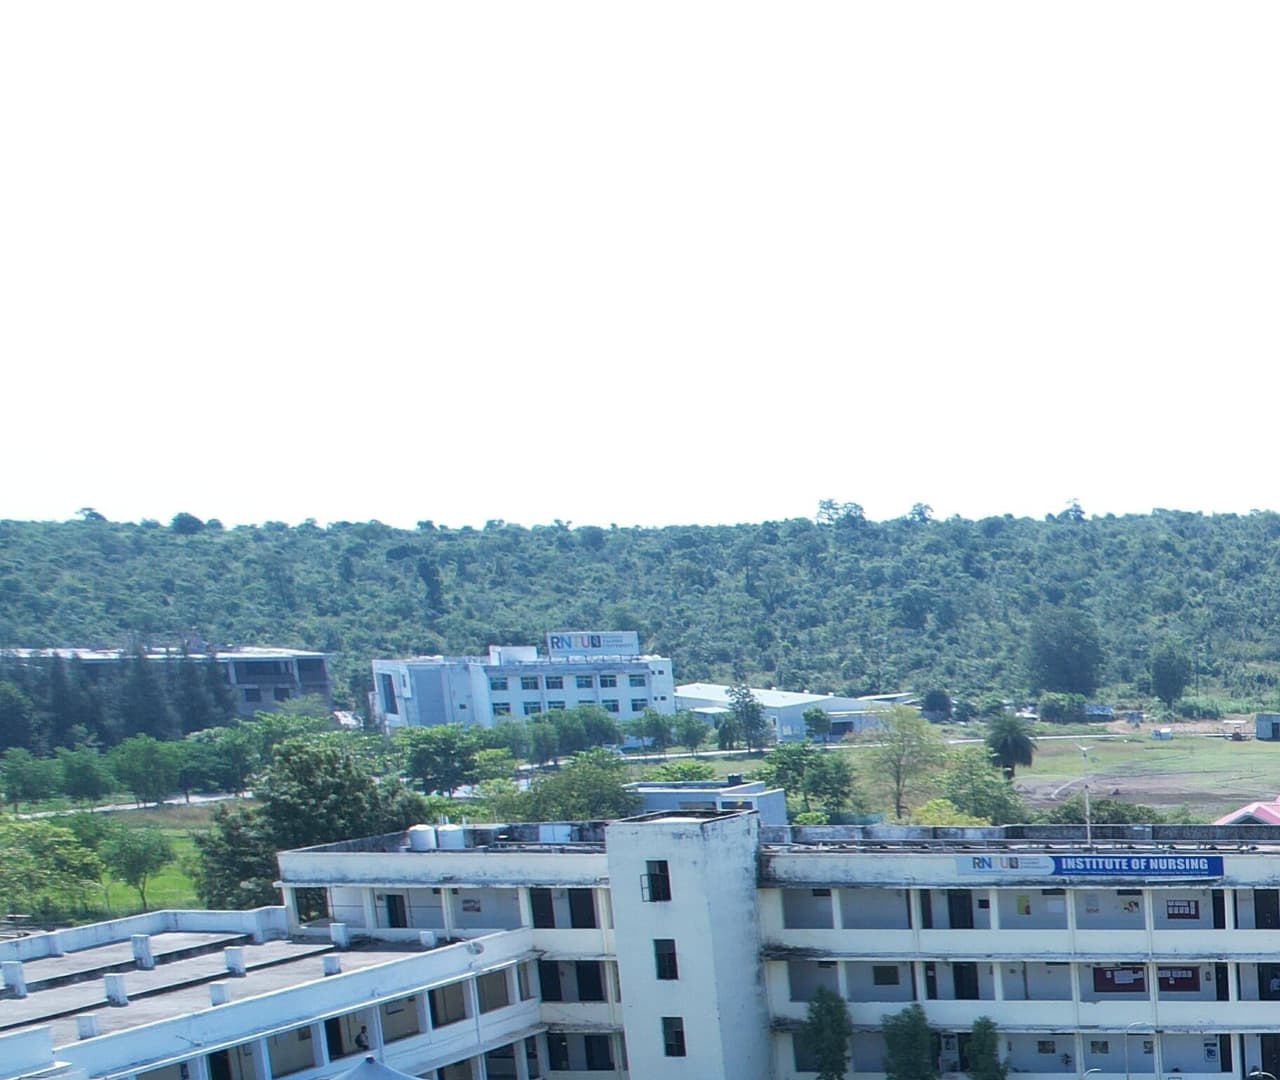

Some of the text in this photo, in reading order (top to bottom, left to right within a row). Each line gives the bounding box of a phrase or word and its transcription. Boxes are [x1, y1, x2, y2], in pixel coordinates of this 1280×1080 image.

[1062, 858, 1128, 870] INSTITUTE
[1131, 858, 1147, 870] OF
[1150, 858, 1209, 870] NURSING
